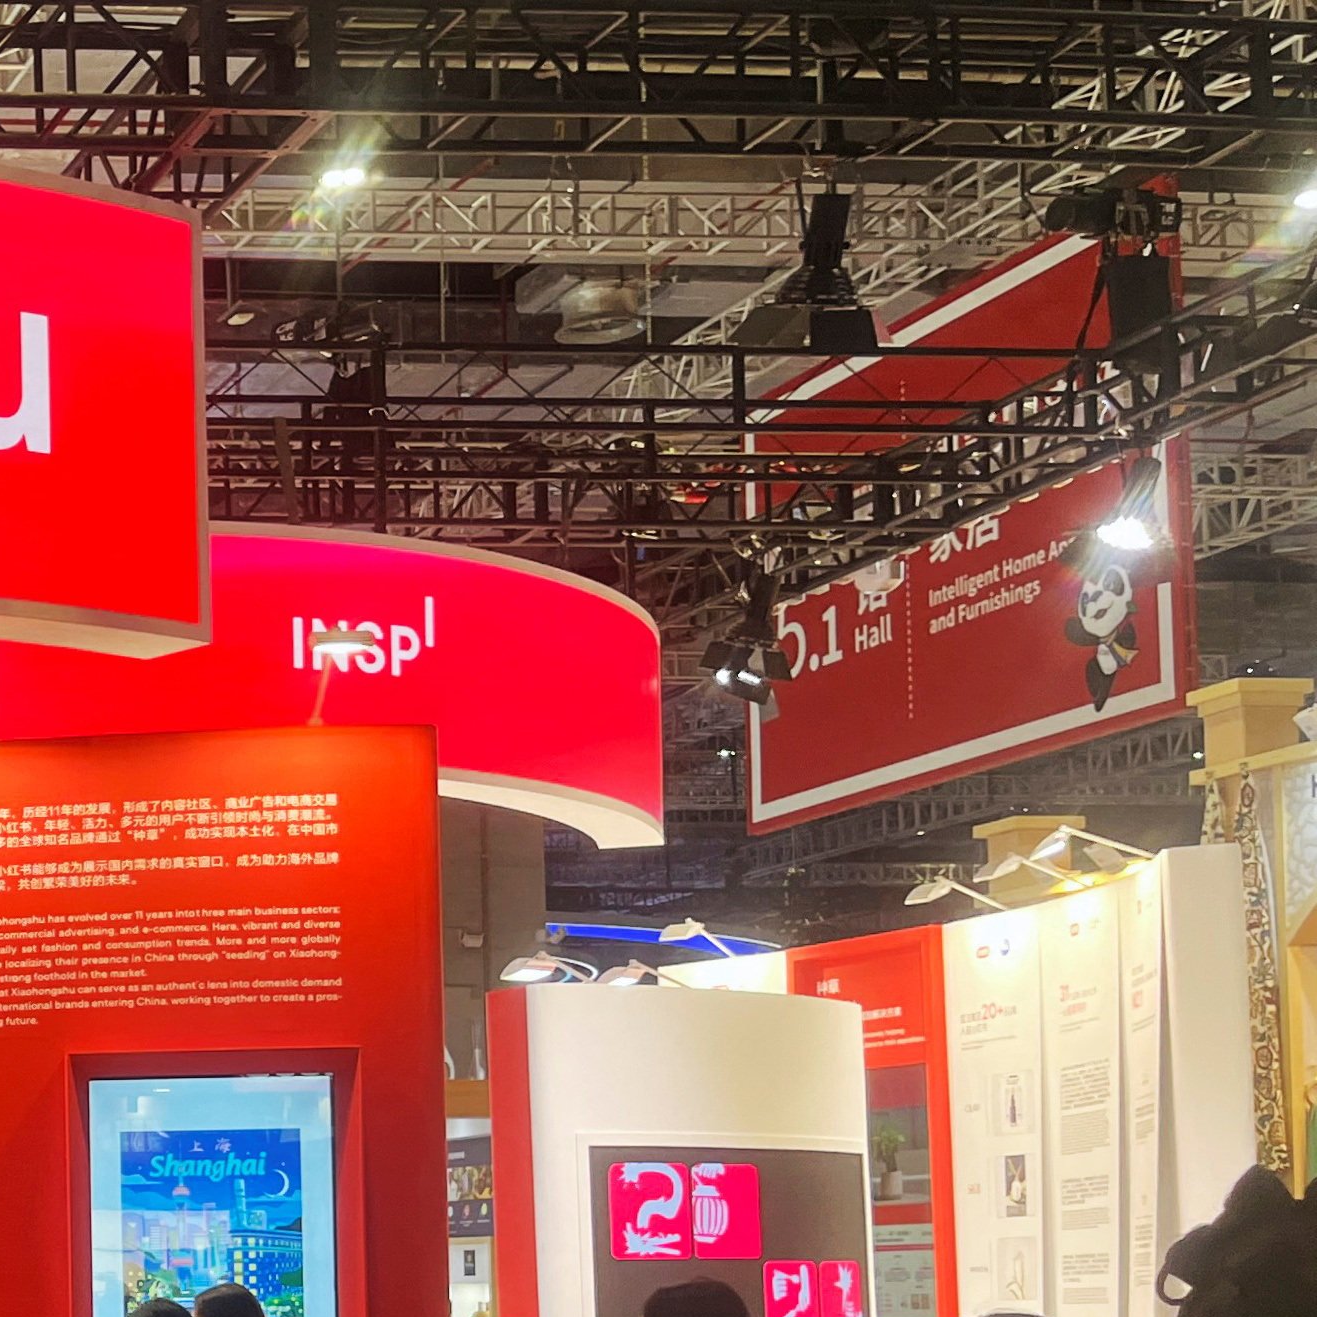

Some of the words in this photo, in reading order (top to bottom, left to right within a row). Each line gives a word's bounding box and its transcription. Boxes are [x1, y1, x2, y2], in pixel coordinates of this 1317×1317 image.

[928, 564, 1002, 607] Intelligent
[1002, 548, 1046, 579] Home
[928, 606, 956, 634] and
[957, 580, 1041, 625] Furnishings
[776, 603, 843, 679] 5.1
[854, 613, 893, 653] Hall
[47, 913, 66, 923] has
[66, 911, 108, 922] evolved
[109, 912, 133, 920] over
[134, 910, 143, 919] 11
[145, 910, 174, 921] years
[227, 906, 252, 916] main
[253, 904, 300, 916] business
[119, 925, 140, 934] and
[241, 919, 278, 931] vibrant
[280, 919, 301, 929] and
[303, 918, 341, 929] diverse
[21, 944, 37, 953] set
[40, 941, 78, 952] fashion
[81, 940, 102, 951] and
[105, 938, 172, 951] consumption
[215, 935, 243, 946] More
[246, 934, 267, 945] and
[270, 935, 297, 945] more
[300, 933, 341, 945] globally
[4, 957, 52, 970] localizing
[54, 956, 79, 966] their
[81, 955, 129, 966] presence
[131, 953, 142, 963] in
[143, 951, 175, 962] China
[177, 950, 219, 963] through
[272, 950, 286, 958] on
[289, 946, 340, 961] Xiaohong-
[32, 970, 77, 981] foothold
[77, 970, 88, 979] in
[89, 969, 108, 979] the
[10, 986, 76, 998] Xiaohongshu
[76, 984, 96, 994] can
[97, 984, 126, 993] serve
[127, 984, 139, 992] as
[140, 983, 154, 992] an
[206, 979, 228, 989] lens
[229, 979, 250, 988] into
[251, 977, 299, 988] domestic
[299, 976, 342, 987] demand
[54, 999, 90, 1009] brands
[90, 998, 135, 1009] entering
[170, 994, 211, 1007] working
[212, 993, 258, 1005] together
[259, 993, 271, 1002] to
[272, 993, 306, 1002] create
[307, 993, 314, 1001] a
[315, 992, 342, 1002] pros-
[189, 1137, 233, 1153] 上海
[149, 1151, 267, 1182] Shanghai
